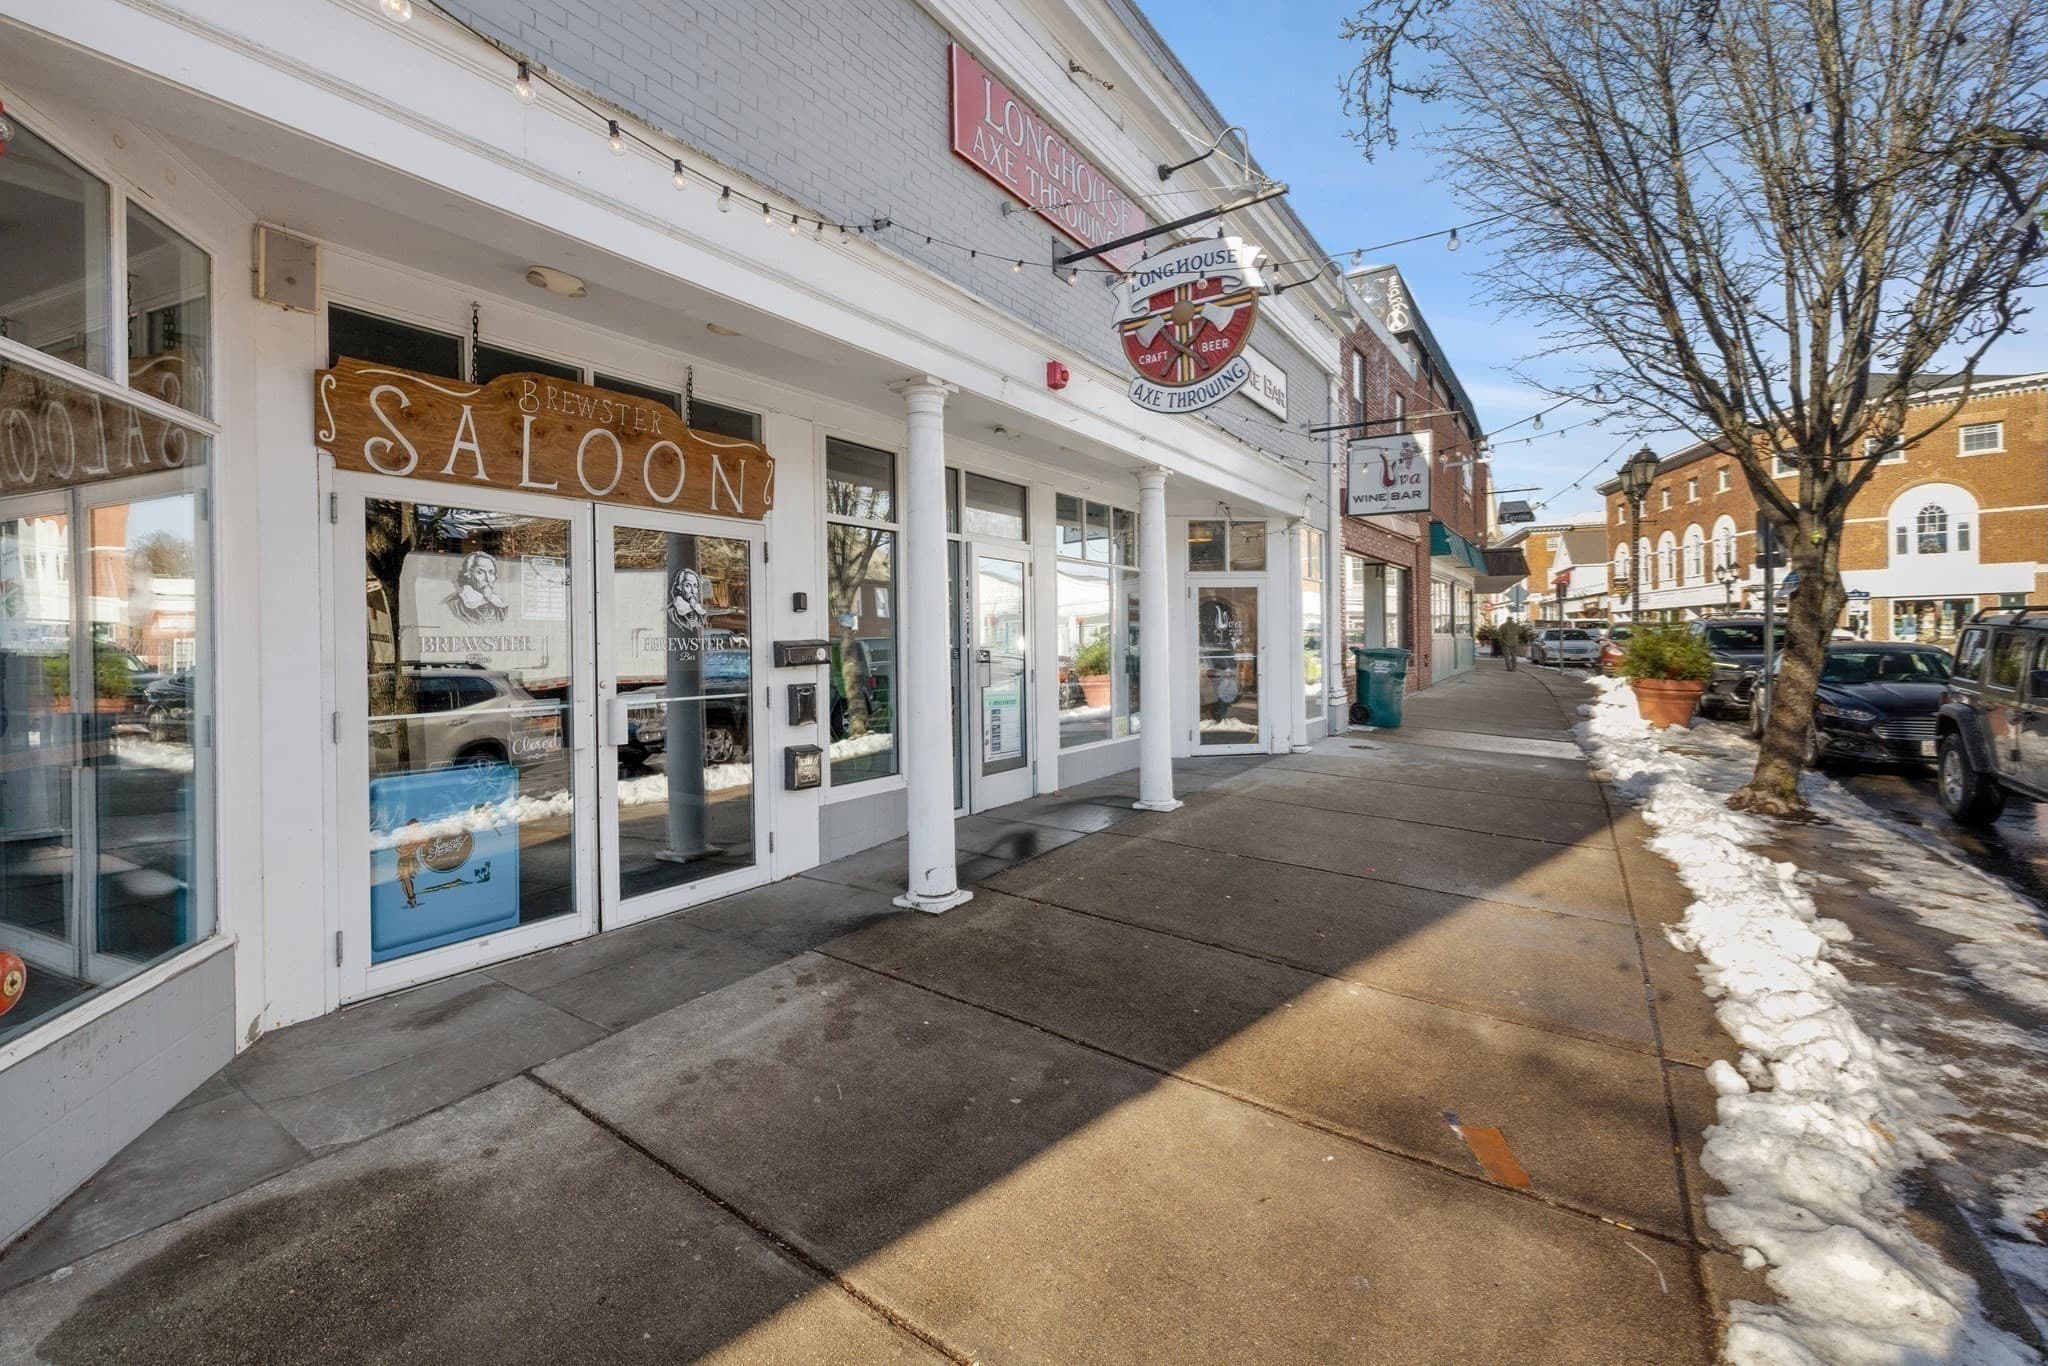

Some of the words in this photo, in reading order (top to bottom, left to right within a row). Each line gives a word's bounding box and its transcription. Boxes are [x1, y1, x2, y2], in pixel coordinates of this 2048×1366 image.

[983, 75, 1131, 237] LONGHOUSE
[973, 125, 1018, 184] AXE
[1025, 164, 1120, 259] THROWING
[1131, 249, 1237, 293] LONGHOUSE
[1138, 351, 1169, 365] CRAFT
[1201, 338, 1229, 352] BEER
[519, 379, 662, 434] BREWSTER
[1133, 384, 1163, 407] AXE
[1167, 363, 1245, 408] THROWING
[363, 384, 746, 513] SALOON
[1352, 493, 1387, 504] WINE
[1391, 490, 1422, 501] BAR
[421, 635, 537, 653] BREWSTER
[643, 637, 724, 652] BREWSTER
